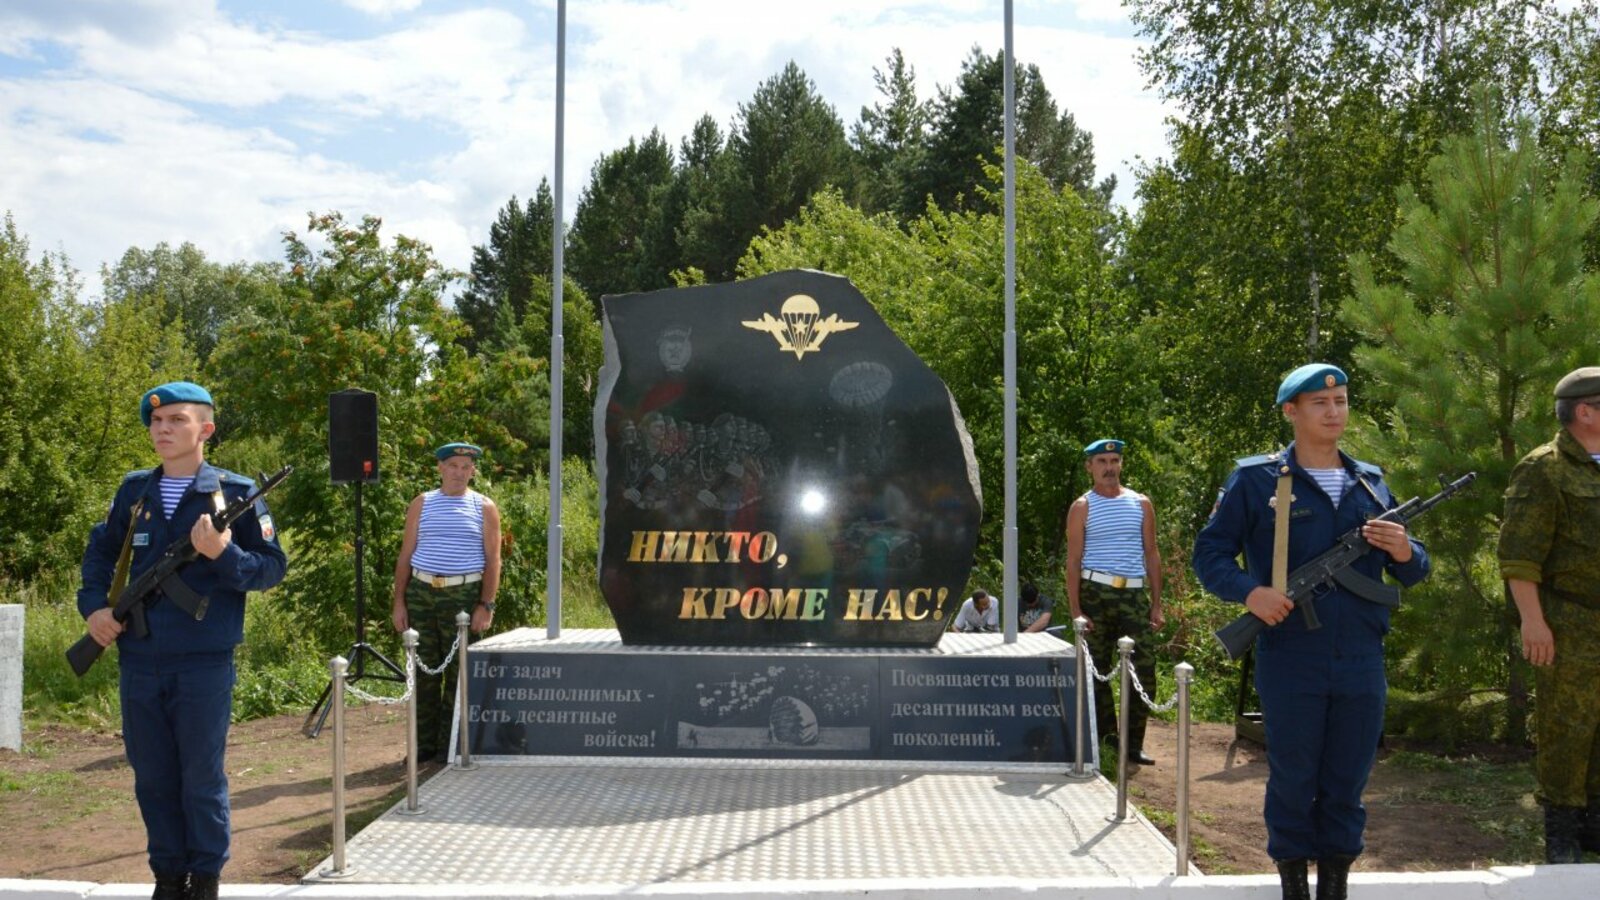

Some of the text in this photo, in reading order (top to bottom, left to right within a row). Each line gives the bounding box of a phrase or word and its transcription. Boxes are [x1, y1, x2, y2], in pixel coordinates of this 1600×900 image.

[626, 530, 788, 569] НИКТО,
[678, 587, 948, 620] КРОМЕ НАС!
[472, 660, 562, 680] Нет задач
[891, 669, 1010, 688] Посвящается
[495, 687, 642, 703] невыполнимых
[468, 704, 617, 725] Есть десантные
[891, 703, 1061, 718] десантникам всех
[583, 729, 656, 748] войска!
[892, 729, 1001, 746] поколений.
